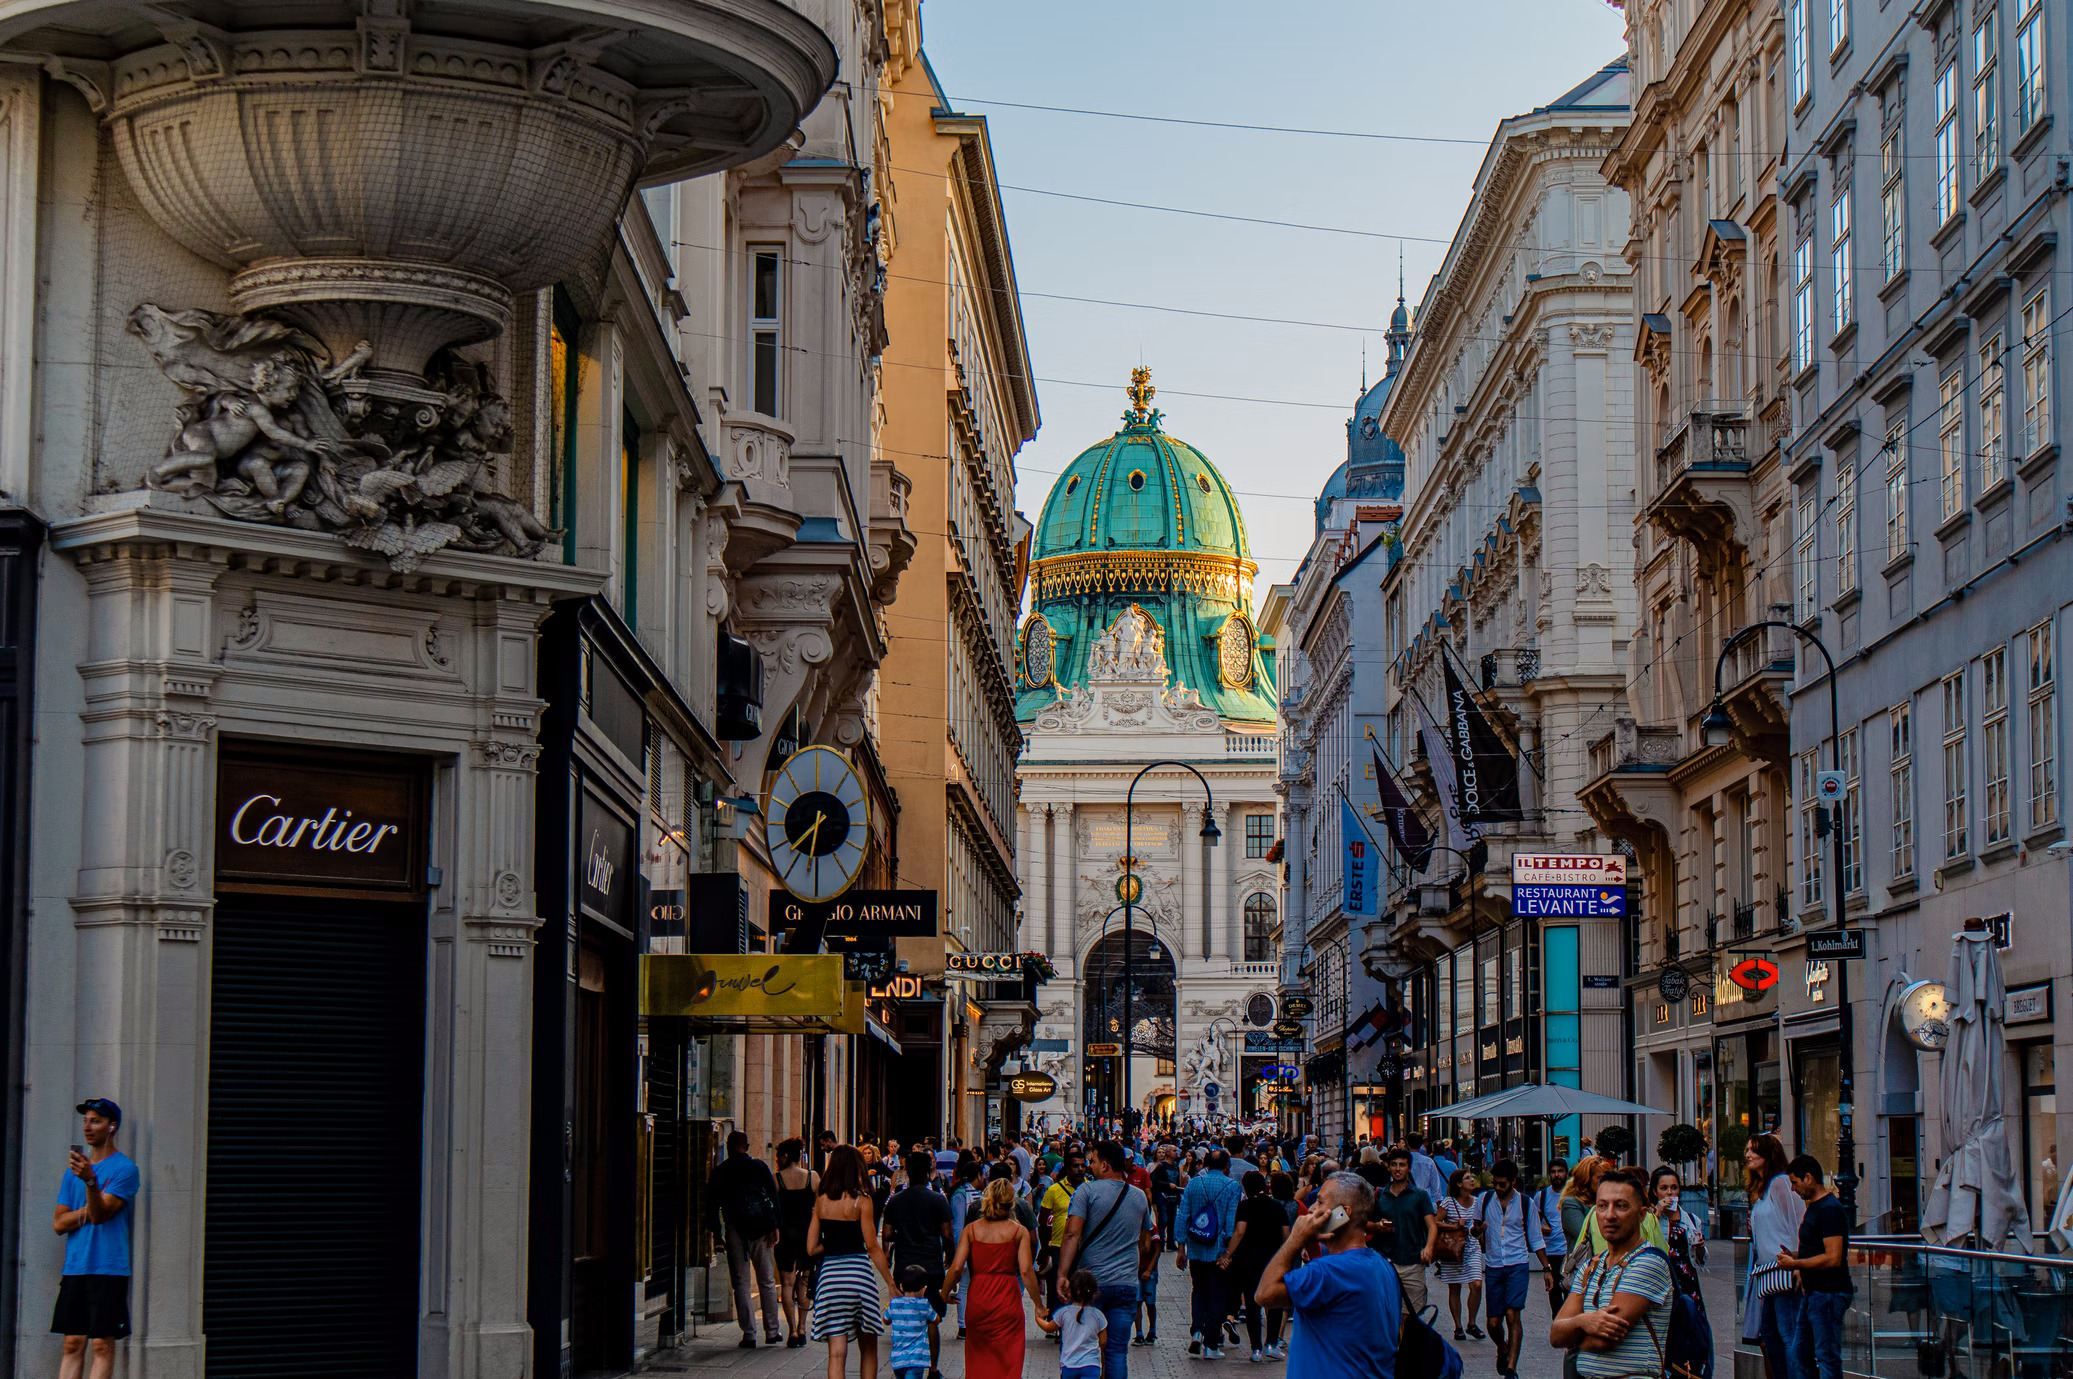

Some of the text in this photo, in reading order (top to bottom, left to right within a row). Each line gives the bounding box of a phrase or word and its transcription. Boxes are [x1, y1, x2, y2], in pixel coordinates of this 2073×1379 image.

[1452, 689, 1473, 761] GABBANA
[1463, 768, 1480, 815] DOLCE
[231, 794, 398, 854] Cartier
[587, 828, 614, 896] Cartier
[1517, 858, 1601, 868] IL TEMPO
[1349, 861, 1364, 912] ERSTE
[1517, 888, 1598, 898] RESTAURANT
[859, 905, 921, 921] ARMANI
[1517, 900, 1598, 914] LEVANTE
[1818, 938, 1859, 951] Kohlmarkt
[949, 956, 1021, 969] GUCCI
[1661, 975, 1685, 985] Tabak
[1011, 1079, 1025, 1089] GS
